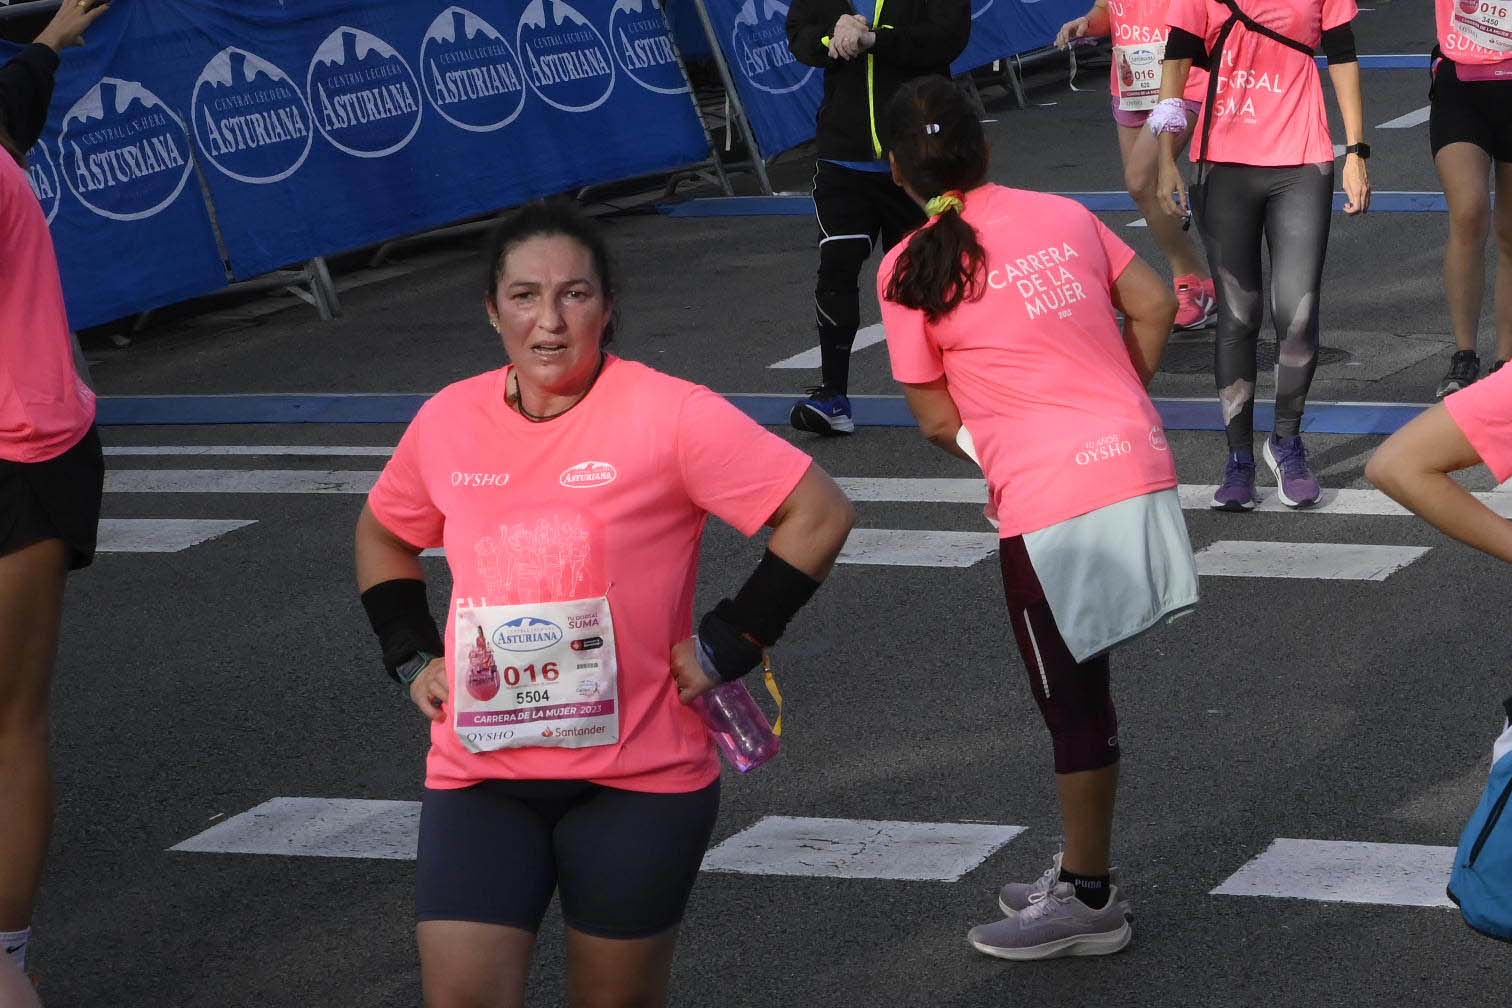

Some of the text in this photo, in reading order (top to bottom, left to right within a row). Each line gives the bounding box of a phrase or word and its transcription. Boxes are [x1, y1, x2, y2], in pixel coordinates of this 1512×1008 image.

[1480, 2, 1507, 18] 016
[1481, 16, 1499, 27] 3450
[525, 41, 611, 87] ASTURIANA
[430, 57, 522, 106] ASTURIANA
[1134, 69, 1155, 81] 016
[318, 80, 417, 133] ASTURIANA
[203, 104, 307, 157] ASTURIANA
[70, 132, 185, 194] ASTURIANA
[987, 242, 1079, 290] CARRERA
[1016, 266, 1075, 299] DE LA
[1024, 281, 1087, 321] MUJER
[1074, 440, 1132, 466] OYSHO
[451, 471, 510, 487] OYSHO
[563, 469, 613, 484] ASTURIANA
[568, 619, 600, 630] SUMA
[497, 630, 558, 645] ASTURIANA
[503, 661, 561, 687] 016
[516, 689, 550, 705] 5504
[473, 705, 602, 724] CARRERA DE LA MUJER 2023
[466, 730, 514, 742] OYSHO
[555, 725, 607, 738] Santander
